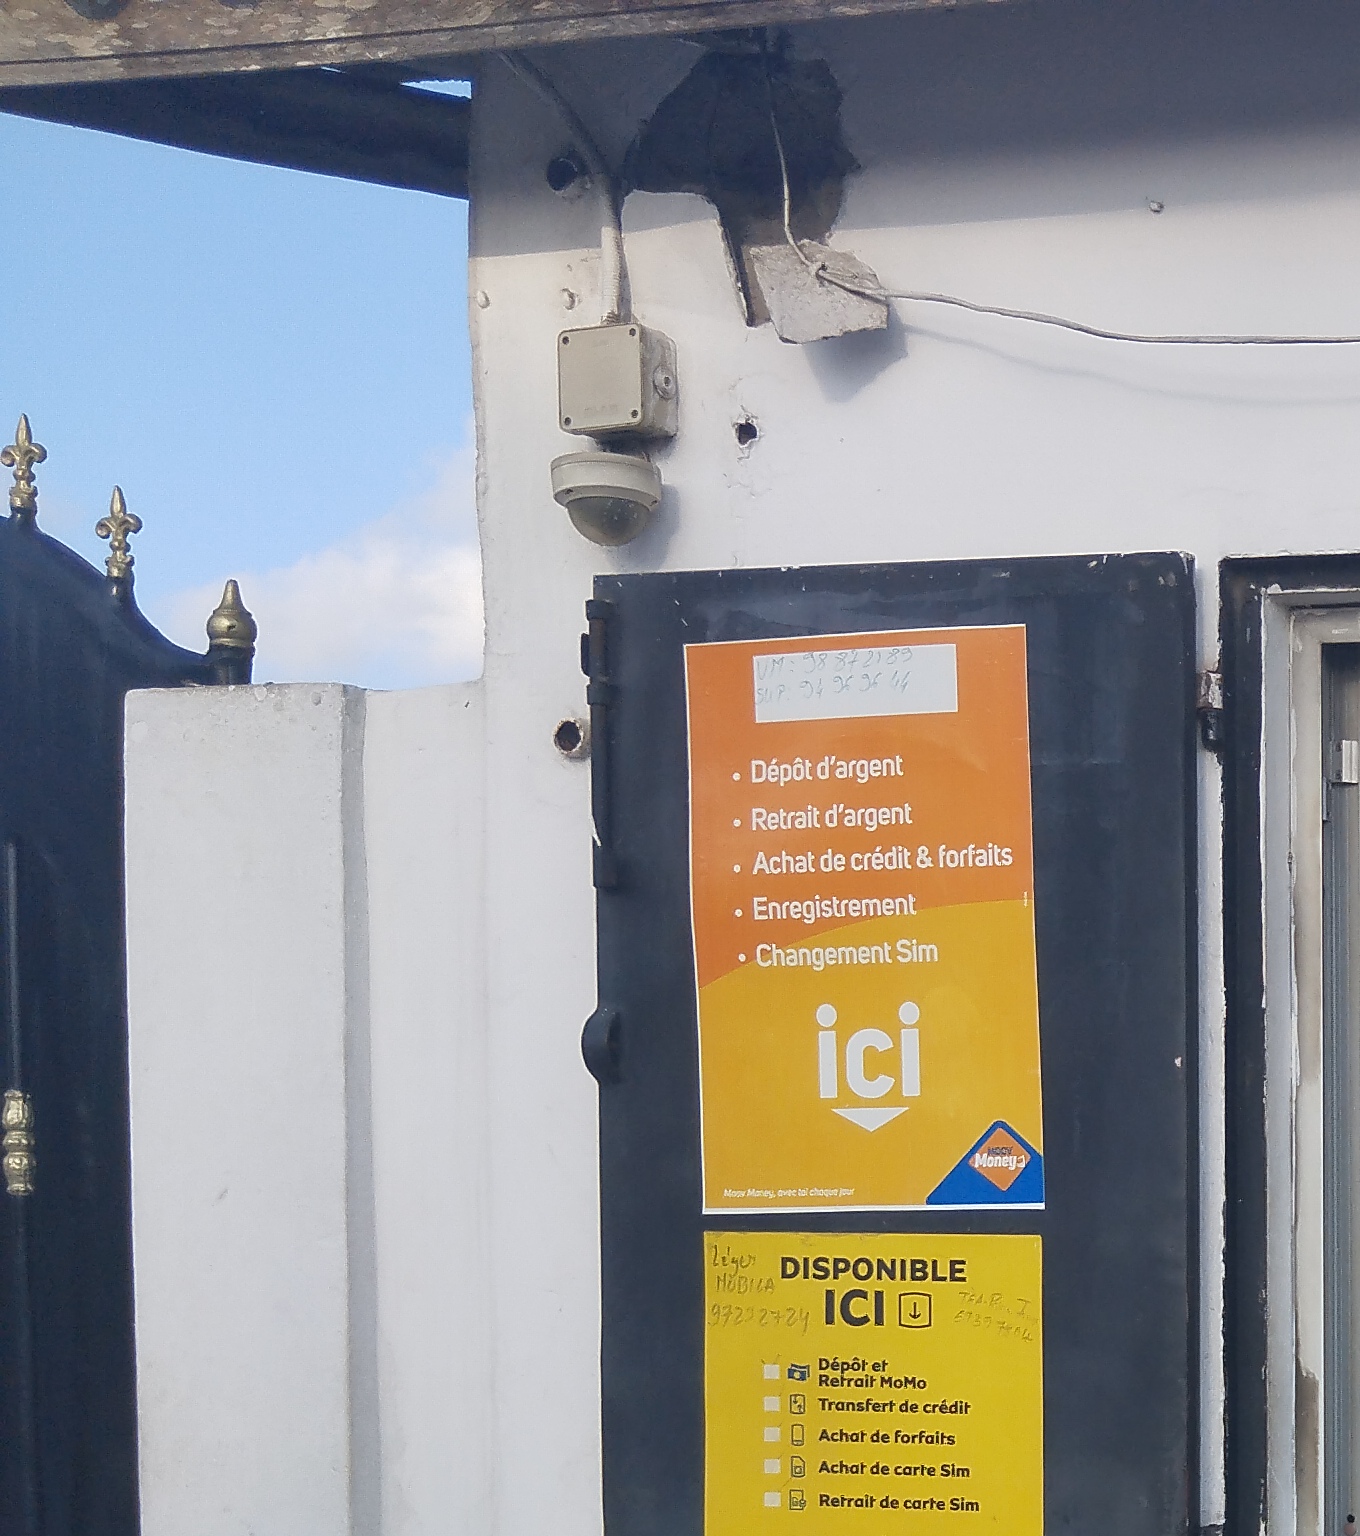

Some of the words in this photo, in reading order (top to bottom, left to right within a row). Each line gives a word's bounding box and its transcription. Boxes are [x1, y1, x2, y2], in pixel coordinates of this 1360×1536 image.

[751, 757, 813, 787] Dépôt
[817, 754, 904, 784] d'argent
[751, 806, 820, 830] Retrait
[825, 802, 912, 833] d'argent
[753, 851, 814, 875] Achat
[820, 848, 846, 872] de
[850, 845, 911, 872] crédit
[916, 845, 933, 868] &
[938, 842, 1014, 868] forfaits
[753, 893, 917, 924] Enregistrement
[756, 943, 893, 971] Changement
[896, 939, 939, 963] Sim
[815, 1001, 921, 1099] ici
[974, 1152, 1018, 1171] Money
[780, 1256, 967, 1283] DISPONIBLE
[824, 1289, 885, 1327] ICI
[818, 1357, 867, 1376] Dépôt
[872, 1359, 889, 1373] et
[818, 1374, 875, 1389] Retrait
[880, 1376, 927, 1390] MoMo
[819, 1398, 894, 1412] Transfert
[899, 1399, 919, 1413] de
[922, 1398, 971, 1415] crédit
[818, 1428, 866, 1444] Achat
[870, 1429, 890, 1444] de
[894, 1430, 956, 1446] forfaits
[818, 1460, 866, 1476] Achat
[870, 1461, 890, 1476] de
[893, 1464, 936, 1478] carte
[939, 1463, 971, 1478] Sim
[818, 1493, 875, 1509] Retrait
[879, 1495, 899, 1510] de
[903, 1497, 945, 1511] carte
[949, 1497, 980, 1512] Sim
